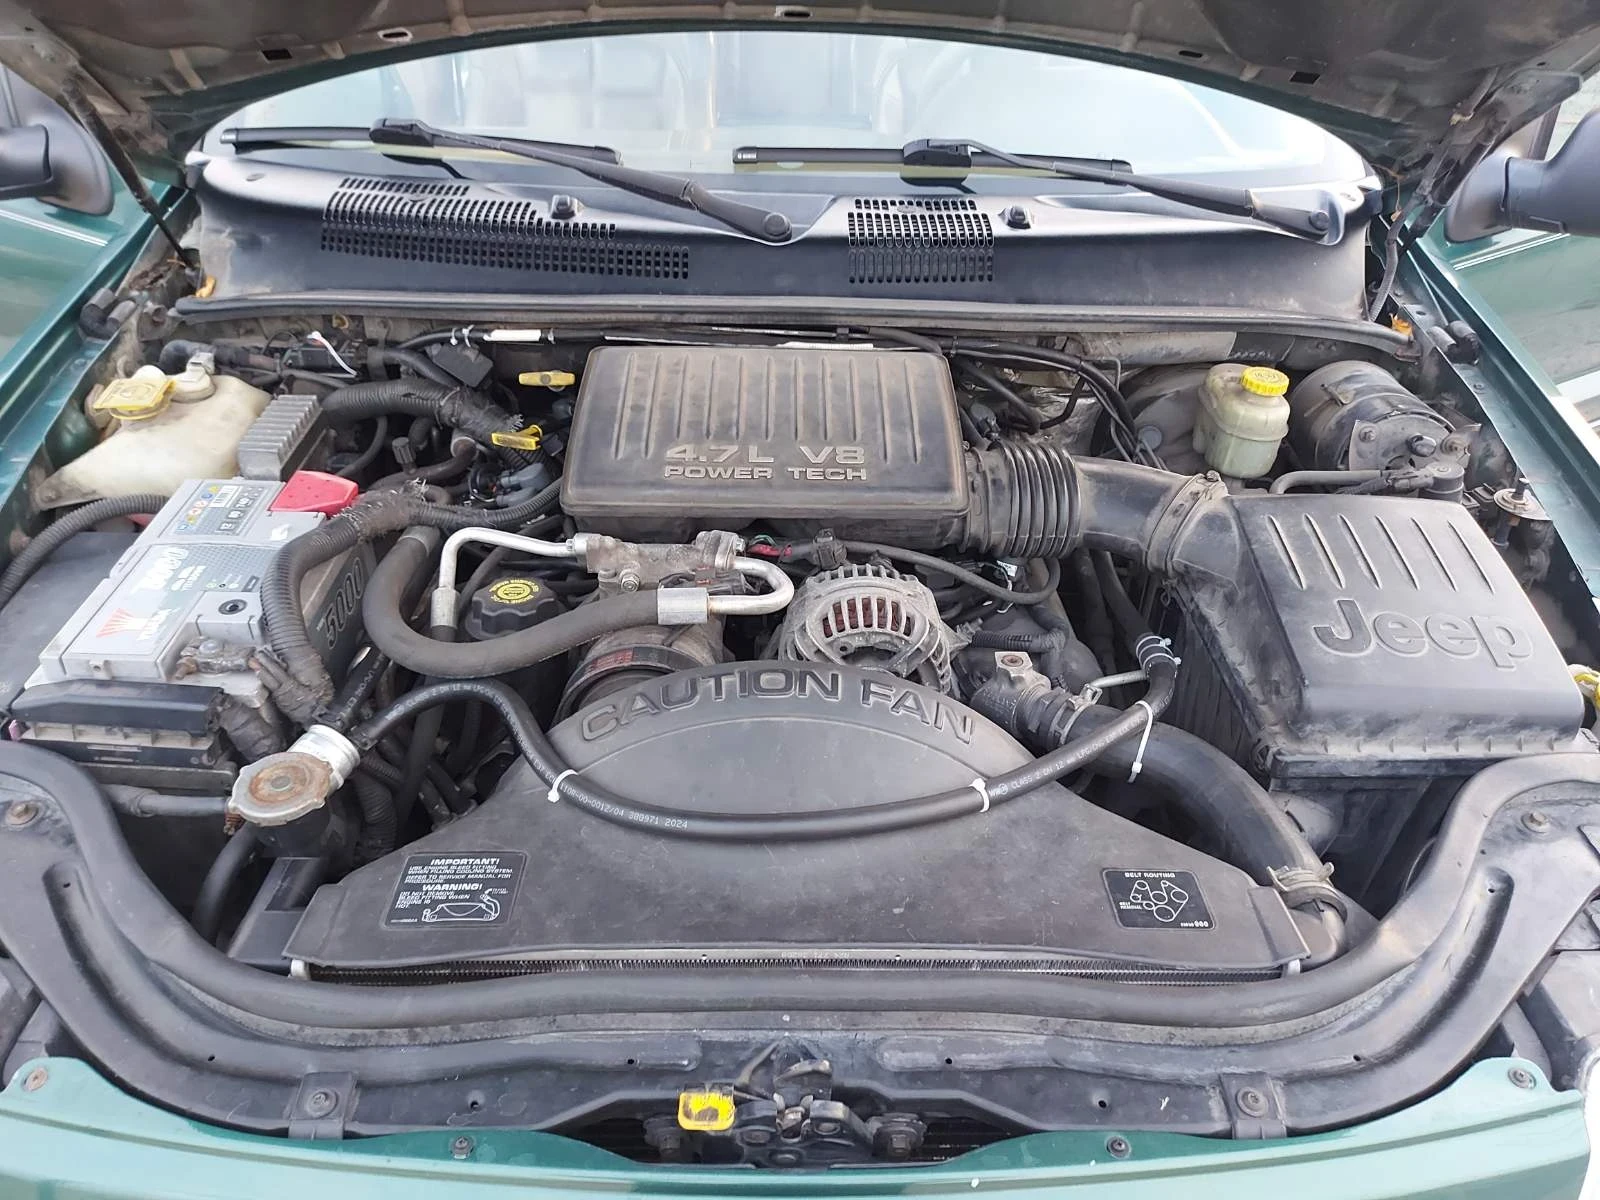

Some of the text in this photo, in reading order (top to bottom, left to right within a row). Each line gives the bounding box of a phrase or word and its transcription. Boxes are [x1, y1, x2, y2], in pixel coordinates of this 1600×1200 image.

[665, 445, 866, 465] 4.7L V8
[664, 466, 867, 481] POWER TECH
[324, 556, 365, 650] 5000
[1312, 598, 1536, 670] Jeep
[580, 668, 843, 743] CAUTION
[860, 678, 977, 746] FAN
[664, 818, 688, 829] 2024
[430, 858, 500, 866] IMPORTANT!
[422, 883, 483, 891] WARNING!
